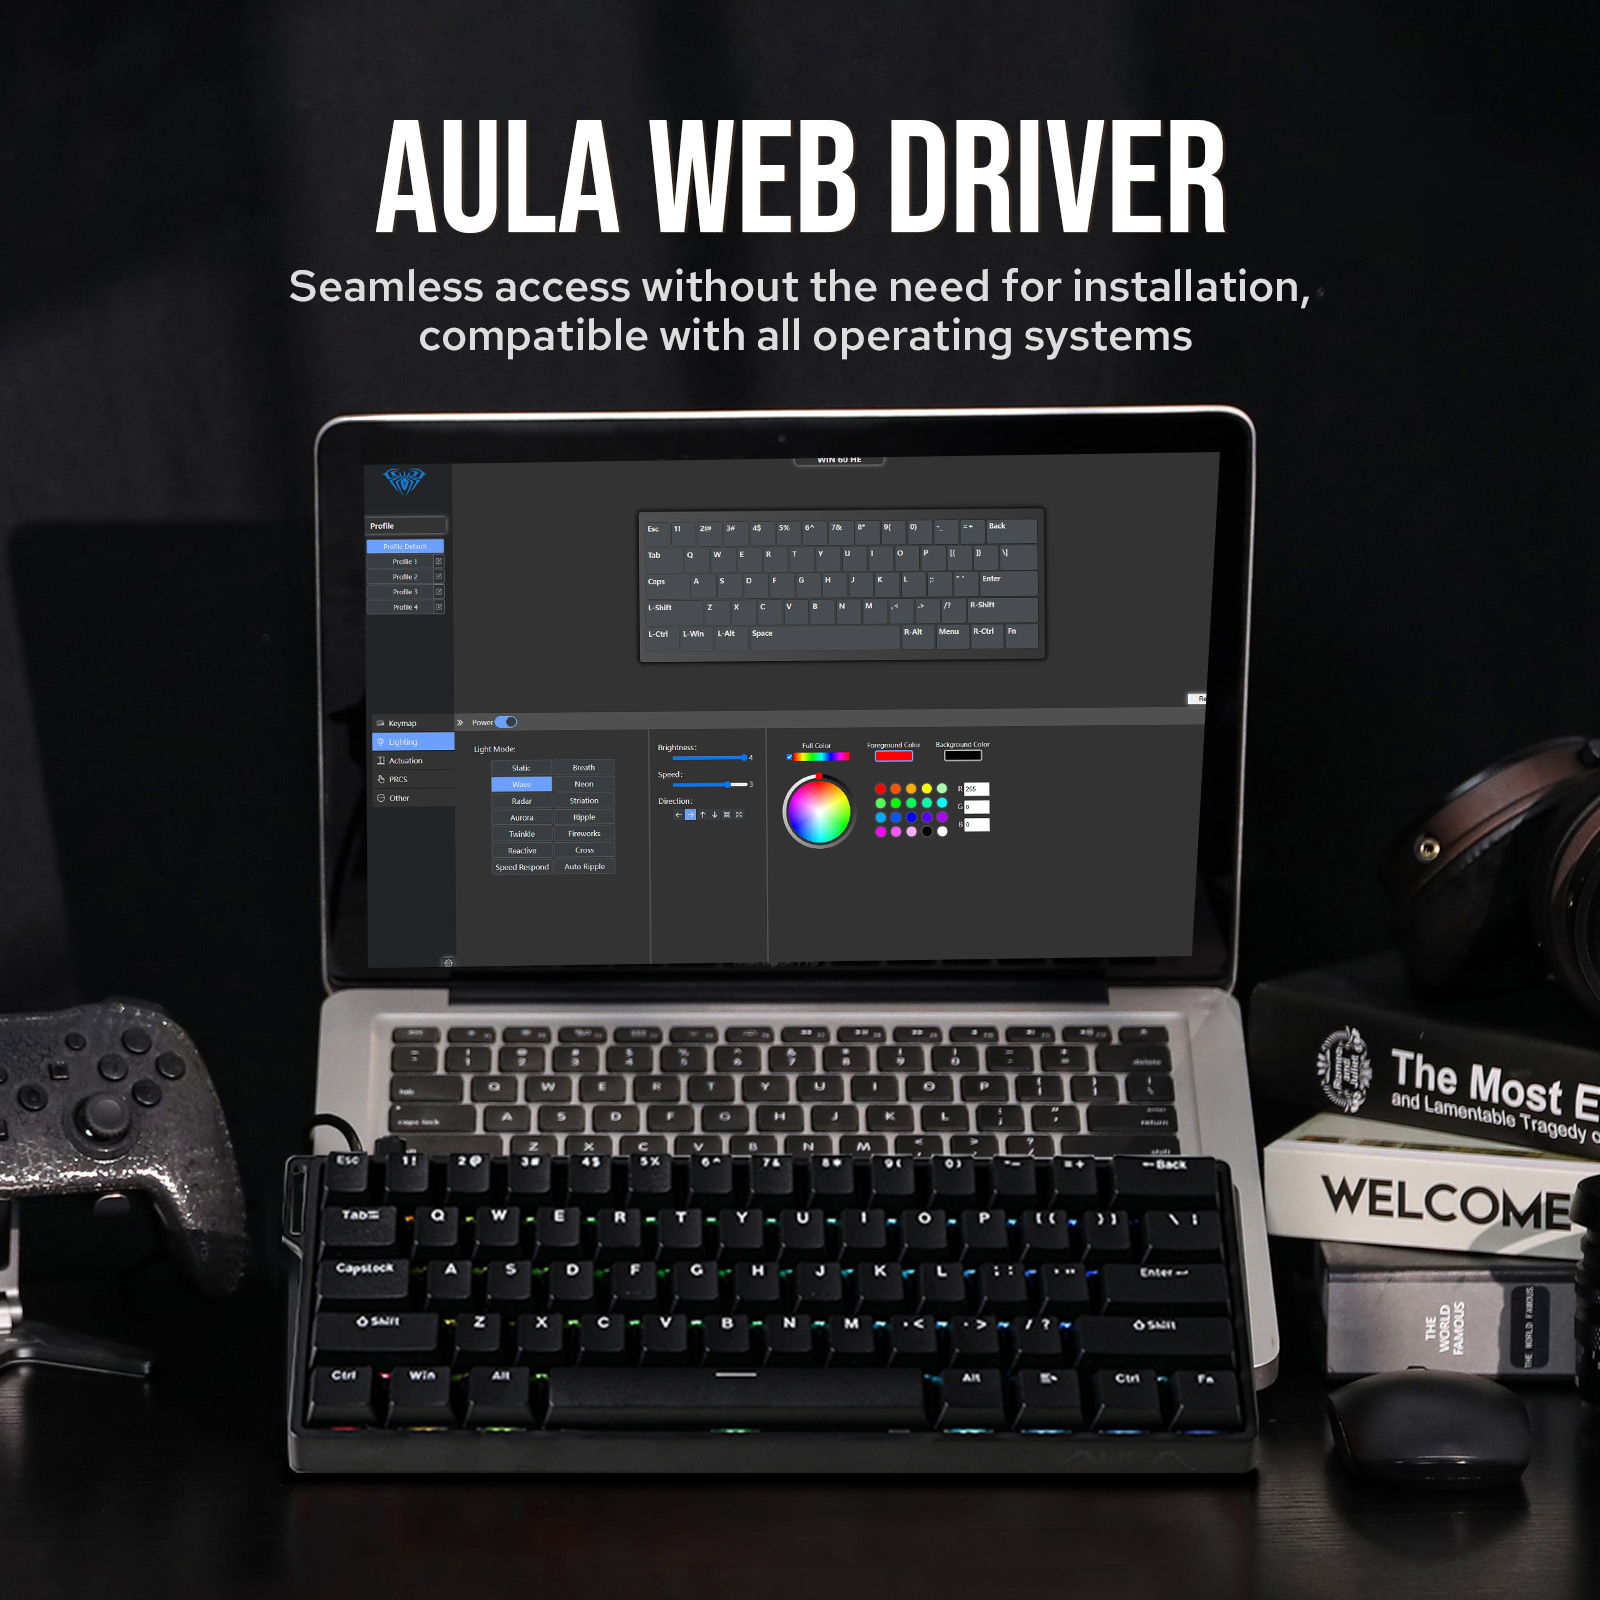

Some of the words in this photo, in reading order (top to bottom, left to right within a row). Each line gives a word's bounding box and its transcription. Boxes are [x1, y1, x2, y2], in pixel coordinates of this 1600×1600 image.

[752, 630, 773, 638] Space
[389, 739, 417, 747] Lighting
[658, 744, 696, 752] Brightness:
[474, 746, 491, 754] Light
[658, 771, 682, 779] Speed:
[574, 814, 595, 822] Ripple
[496, 864, 517, 872] Speed
[584, 863, 605, 871] Ripple
[489, 1083, 500, 1091] Q
[541, 1083, 555, 1091] W
[598, 1082, 606, 1092] E
[980, 1082, 989, 1090] P
[1391, 1048, 1458, 1095] The
[1470, 1063, 1562, 1116] Most
[1392, 1092, 1420, 1110] and
[1424, 1095, 1516, 1128] Lamentable
[1519, 1113, 1587, 1144] Tragedy
[337, 1156, 358, 1164] Esc
[1156, 1160, 1186, 1169] Back
[1321, 1175, 1572, 1231] WELCOME
[343, 1210, 369, 1220] Tab
[431, 1209, 444, 1221] Q
[492, 1210, 507, 1220] W
[555, 1210, 563, 1221] E
[615, 1211, 625, 1222] R
[676, 1211, 686, 1222] T
[737, 1212, 747, 1223] Y
[797, 1212, 808, 1223] U
[862, 1212, 866, 1222] I
[919, 1212, 931, 1223] O
[980, 1212, 990, 1223] P
[336, 1263, 393, 1275] Capslock
[445, 1263, 456, 1274] A
[506, 1264, 516, 1274] S
[567, 1264, 579, 1275] D
[631, 1264, 639, 1275] F
[691, 1264, 703, 1275] G
[753, 1265, 763, 1275] H
[816, 1265, 824, 1276] J
[875, 1265, 886, 1276] K
[937, 1266, 947, 1276] L
[1141, 1268, 1172, 1277] Enter
[1526, 1286, 1534, 1319] FAMOUS
[371, 1317, 399, 1326] Shift
[474, 1316, 484, 1327] Z
[536, 1317, 547, 1327] X
[598, 1317, 609, 1328] C
[660, 1317, 671, 1327] V
[722, 1318, 733, 1328] B
[784, 1318, 795, 1328] N
[845, 1318, 858, 1328] M
[1147, 1321, 1175, 1329] Shift
[1426, 1316, 1436, 1341] THE
[1439, 1304, 1450, 1353] WORLD
[1453, 1301, 1465, 1356] FAMOUS
[1525, 1322, 1533, 1349] WORLD
[1524, 1353, 1533, 1368] THE
[332, 1370, 356, 1380] Ctrl
[410, 1371, 435, 1379] Win
[963, 1374, 980, 1382] Alt
[1115, 1374, 1139, 1383] Ctrl
[1198, 1375, 1213, 1383] Fn
